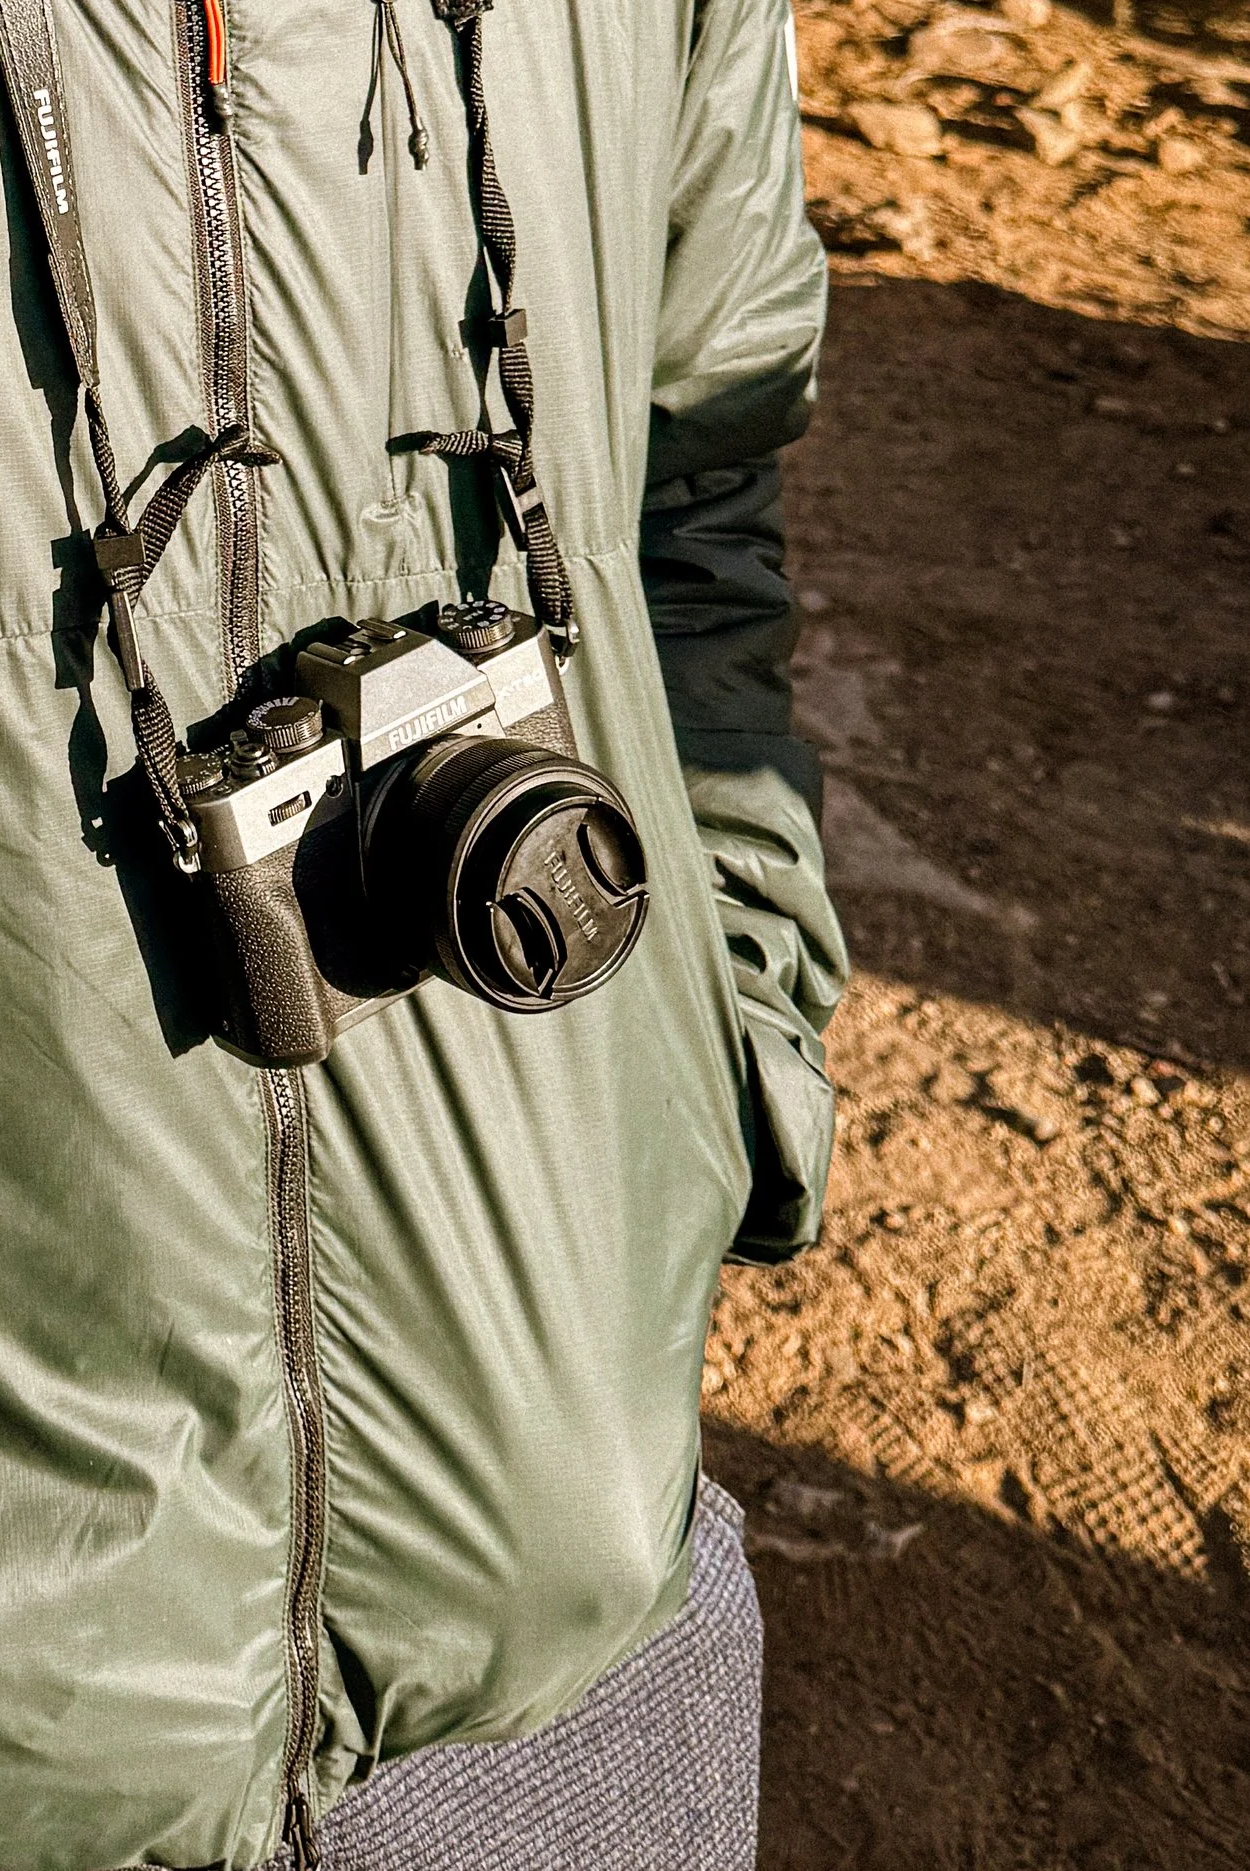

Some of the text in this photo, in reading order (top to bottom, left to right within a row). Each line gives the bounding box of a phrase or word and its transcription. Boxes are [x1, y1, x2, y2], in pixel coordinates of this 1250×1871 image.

[33, 88, 69, 215] FUJIFILM
[388, 695, 467, 751] FUJIFILM
[544, 851, 598, 941] FUJIFILM
